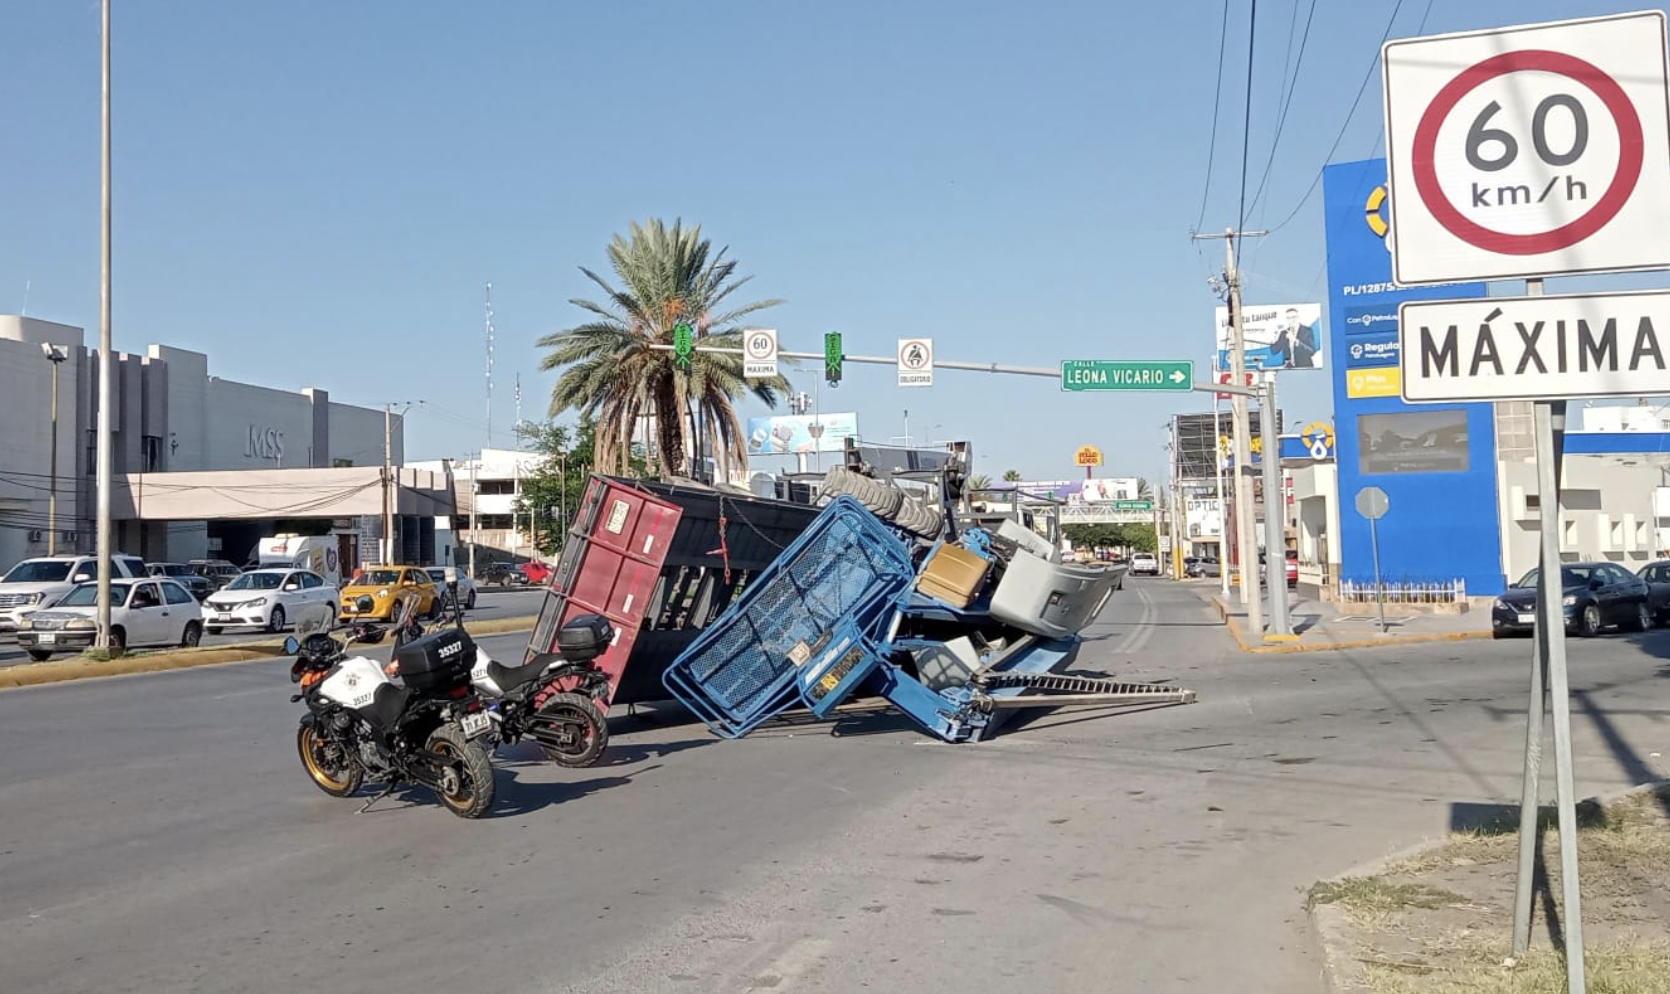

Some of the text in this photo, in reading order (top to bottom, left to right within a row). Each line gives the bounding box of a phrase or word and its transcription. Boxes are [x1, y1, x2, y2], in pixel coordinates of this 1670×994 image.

[1465, 94, 1589, 172] 60
[1472, 175, 1587, 208] km/h
[753, 339, 768, 350] 60
[1365, 341, 1399, 353] Regula
[1419, 307, 1667, 379] MÁXIMA
[1067, 369, 1164, 384] LEONA VICARIO
[1187, 500, 1220, 511] OPTIC
[438, 641, 462, 658] 35327
[352, 692, 371, 706] 35327
